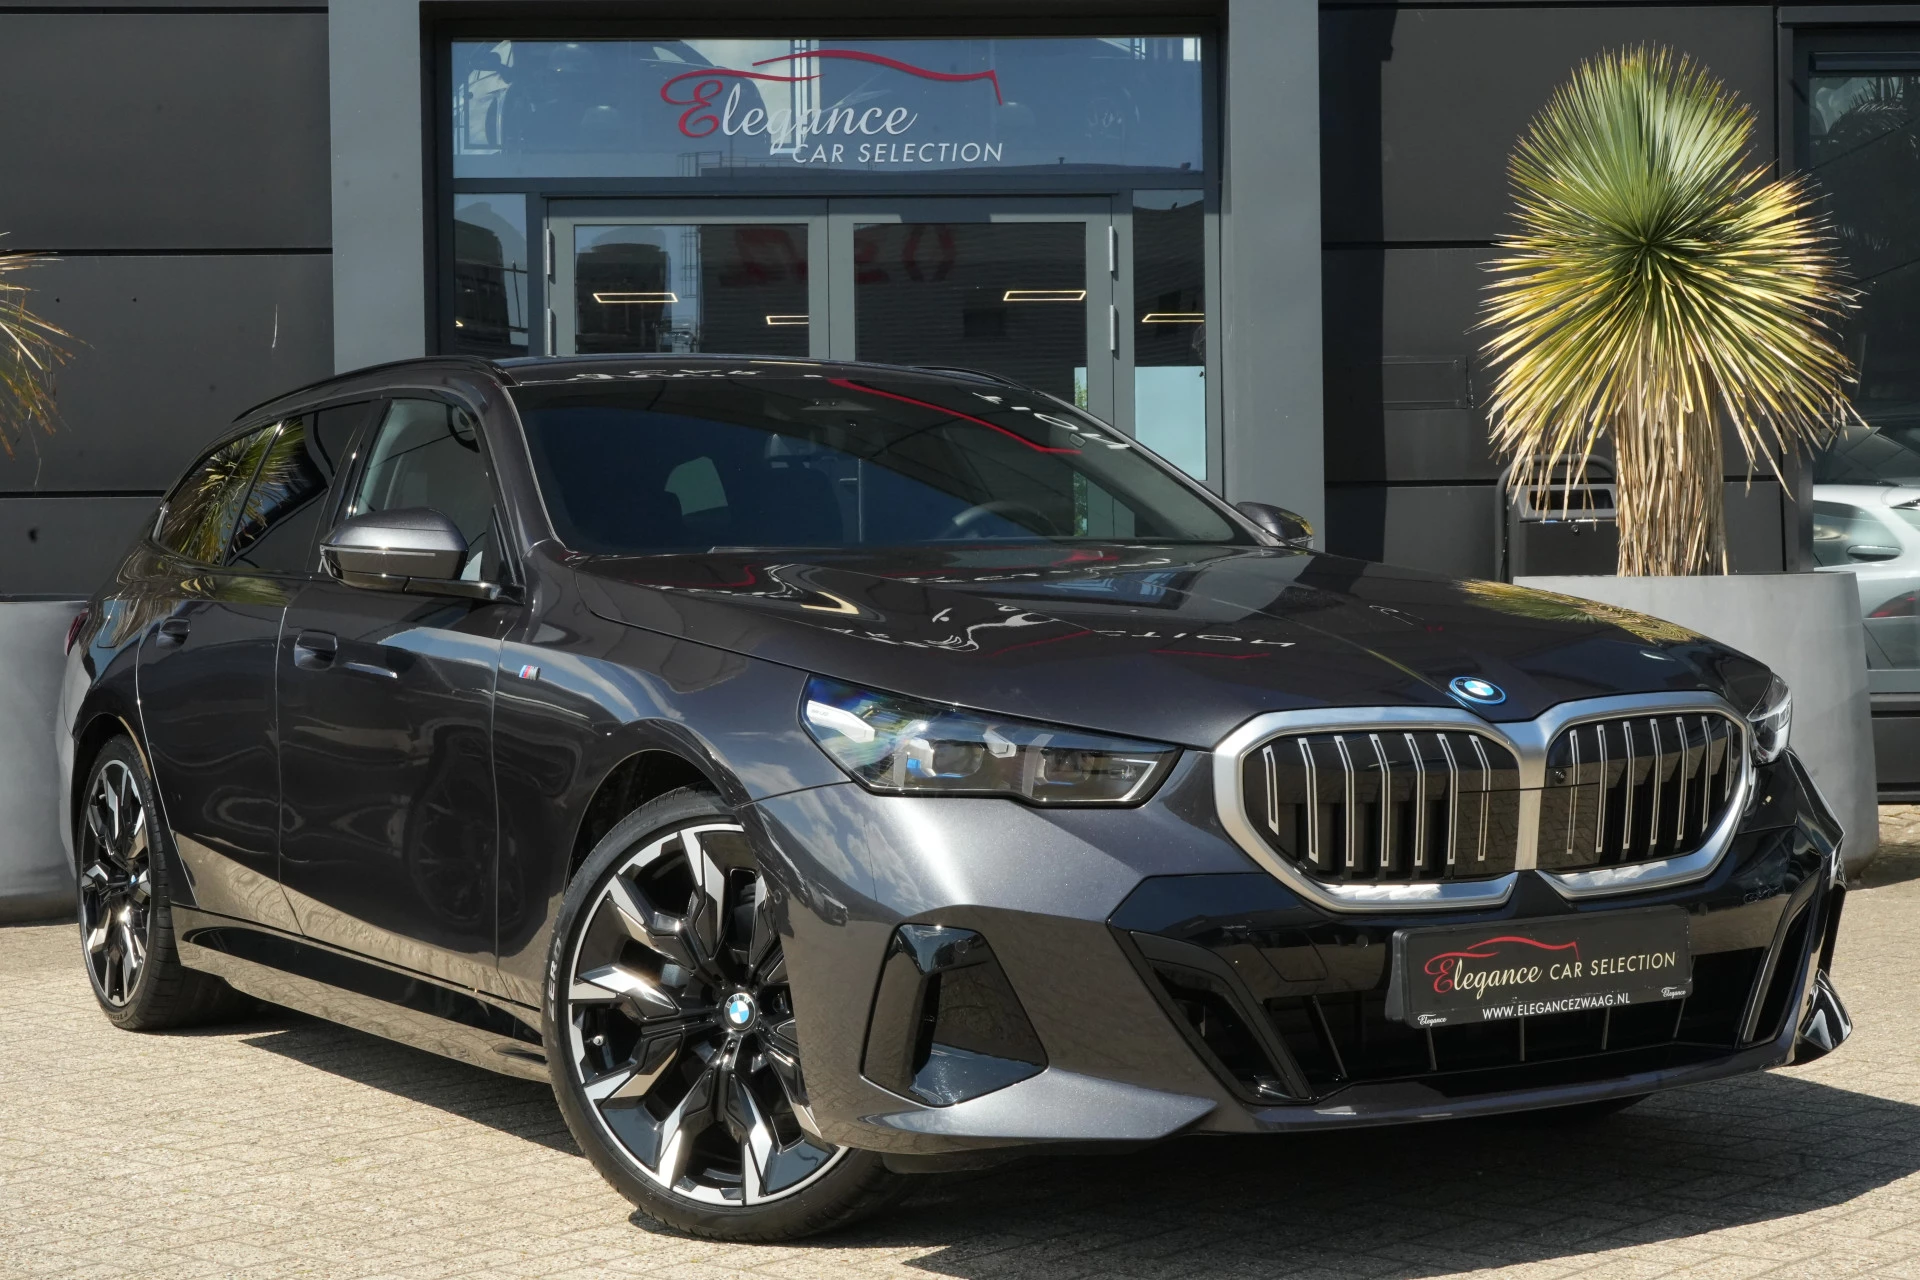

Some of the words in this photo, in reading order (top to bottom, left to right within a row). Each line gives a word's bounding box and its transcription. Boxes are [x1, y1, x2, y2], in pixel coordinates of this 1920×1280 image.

[660, 68, 918, 156] Elegance
[792, 143, 845, 164] CAR
[857, 142, 1003, 163] SELECTION
[547, 937, 562, 1022] ZERO
[1424, 952, 1543, 1000] Elegance
[1549, 961, 1583, 981] CAR
[1590, 951, 1677, 977] SELECTION
[725, 993, 752, 1010] BMW
[1482, 992, 1631, 1020] WWW.ELEGANCEZWAAG.NL
